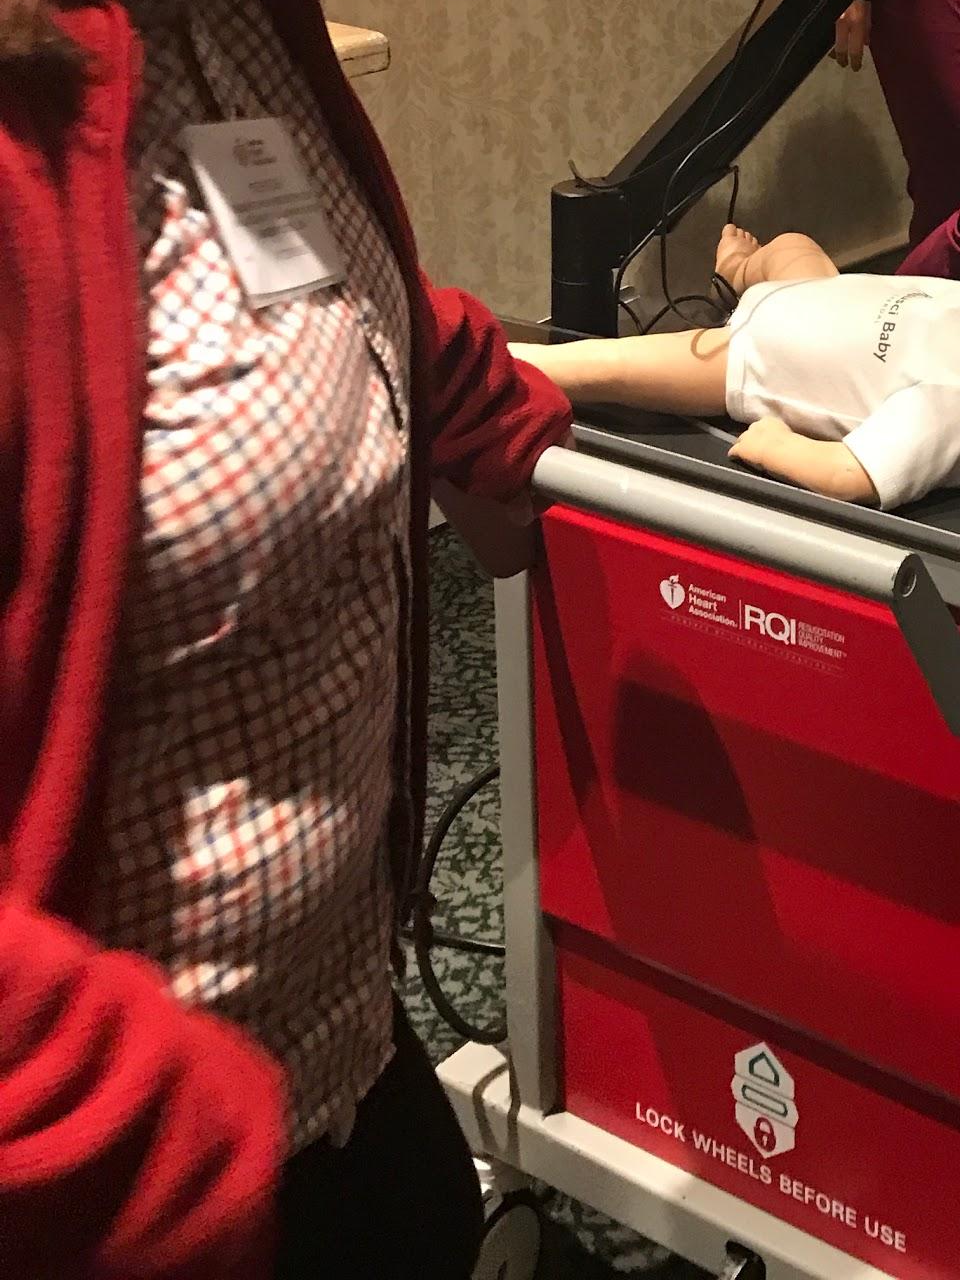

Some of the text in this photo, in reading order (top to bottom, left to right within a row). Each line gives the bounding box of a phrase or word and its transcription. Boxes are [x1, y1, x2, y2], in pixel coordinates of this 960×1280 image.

[873, 321, 896, 363] Baby
[688, 583, 727, 603] American
[688, 593, 718, 612] Heart
[744, 604, 797, 646] RQI
[635, 1102, 907, 1253] LOCK WHEELS BEFORE USE
